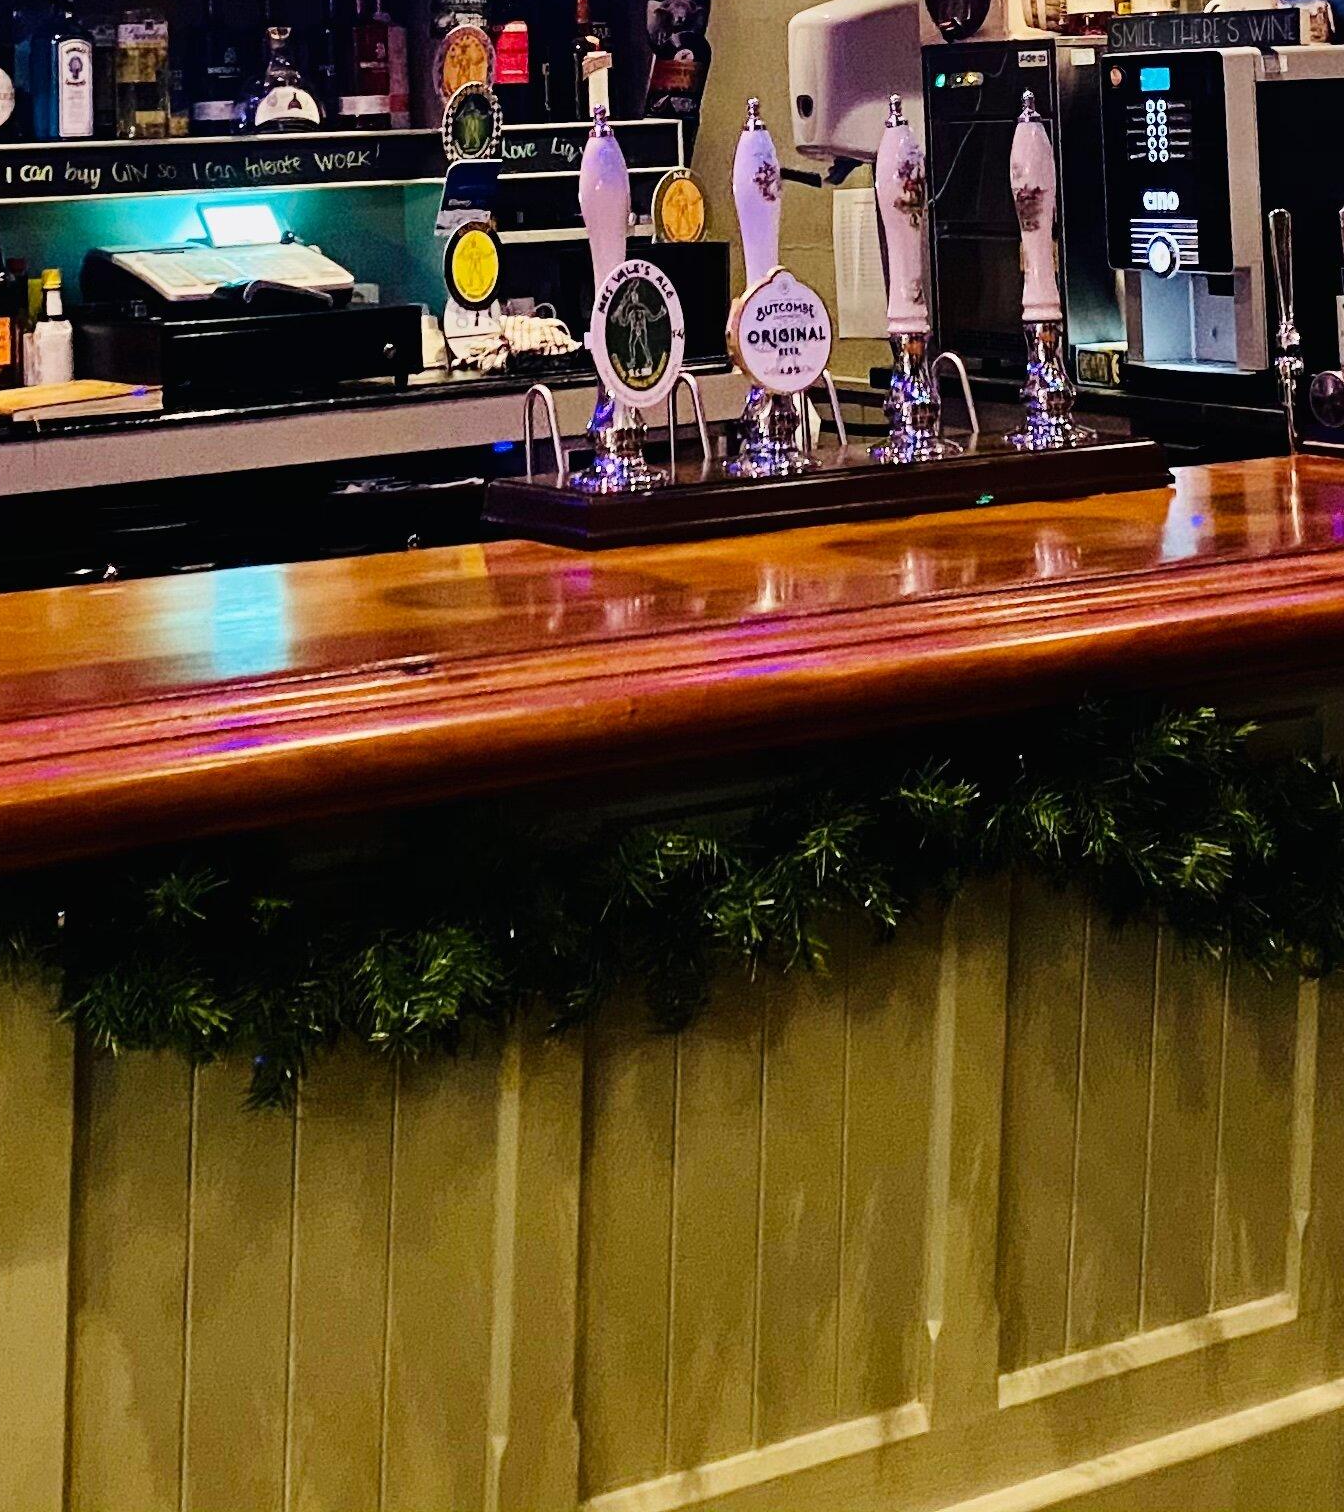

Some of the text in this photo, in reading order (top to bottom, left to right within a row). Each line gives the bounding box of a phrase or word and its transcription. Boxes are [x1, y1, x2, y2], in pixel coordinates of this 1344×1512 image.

[1169, 14, 1296, 45] THERE'S WINE
[501, 139, 538, 160] Love
[20, 164, 54, 184] can
[65, 160, 101, 190] buy
[112, 160, 148, 185] GIN
[156, 162, 177, 180] so
[245, 155, 302, 181] tolerate
[755, 302, 816, 322] BUTCOMBE
[746, 325, 827, 348] ORIGINAL
